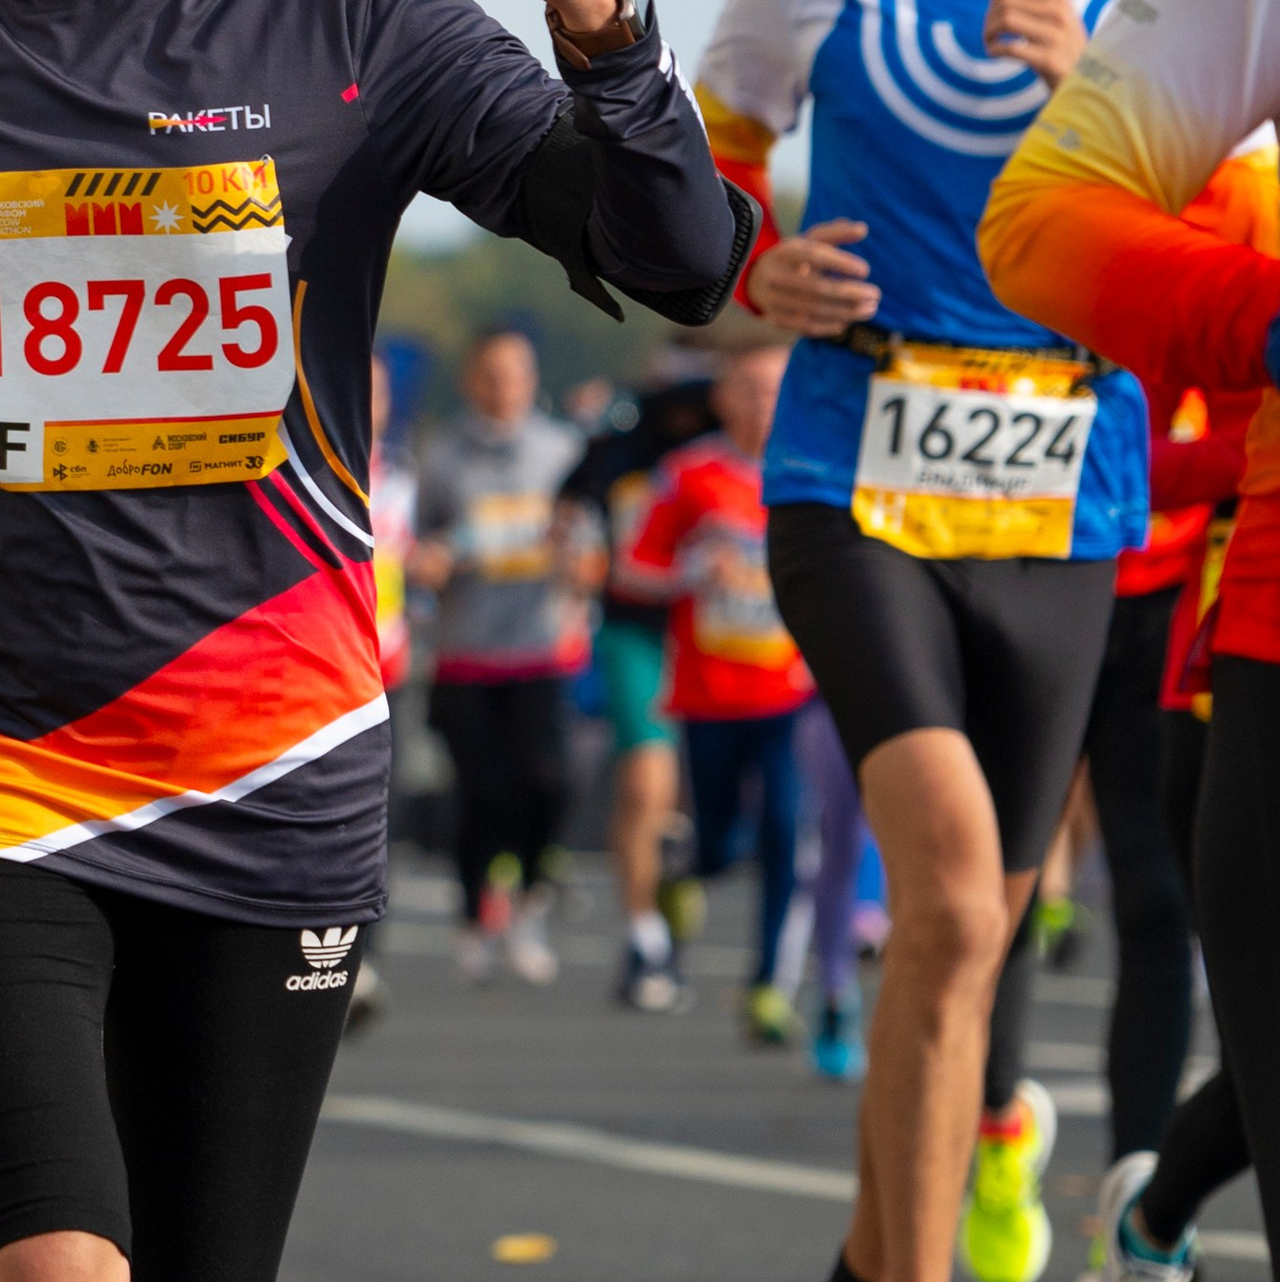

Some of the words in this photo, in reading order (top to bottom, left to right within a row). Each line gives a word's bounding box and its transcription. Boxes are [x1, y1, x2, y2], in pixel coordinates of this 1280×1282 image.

[148, 103, 272, 135] РАКЕТЫ
[183, 169, 215, 196] 10
[219, 432, 266, 445] СИБУР
[880, 393, 1078, 469] 16224
[204, 460, 243, 470] МАГНИТ
[286, 971, 349, 991] adidas
